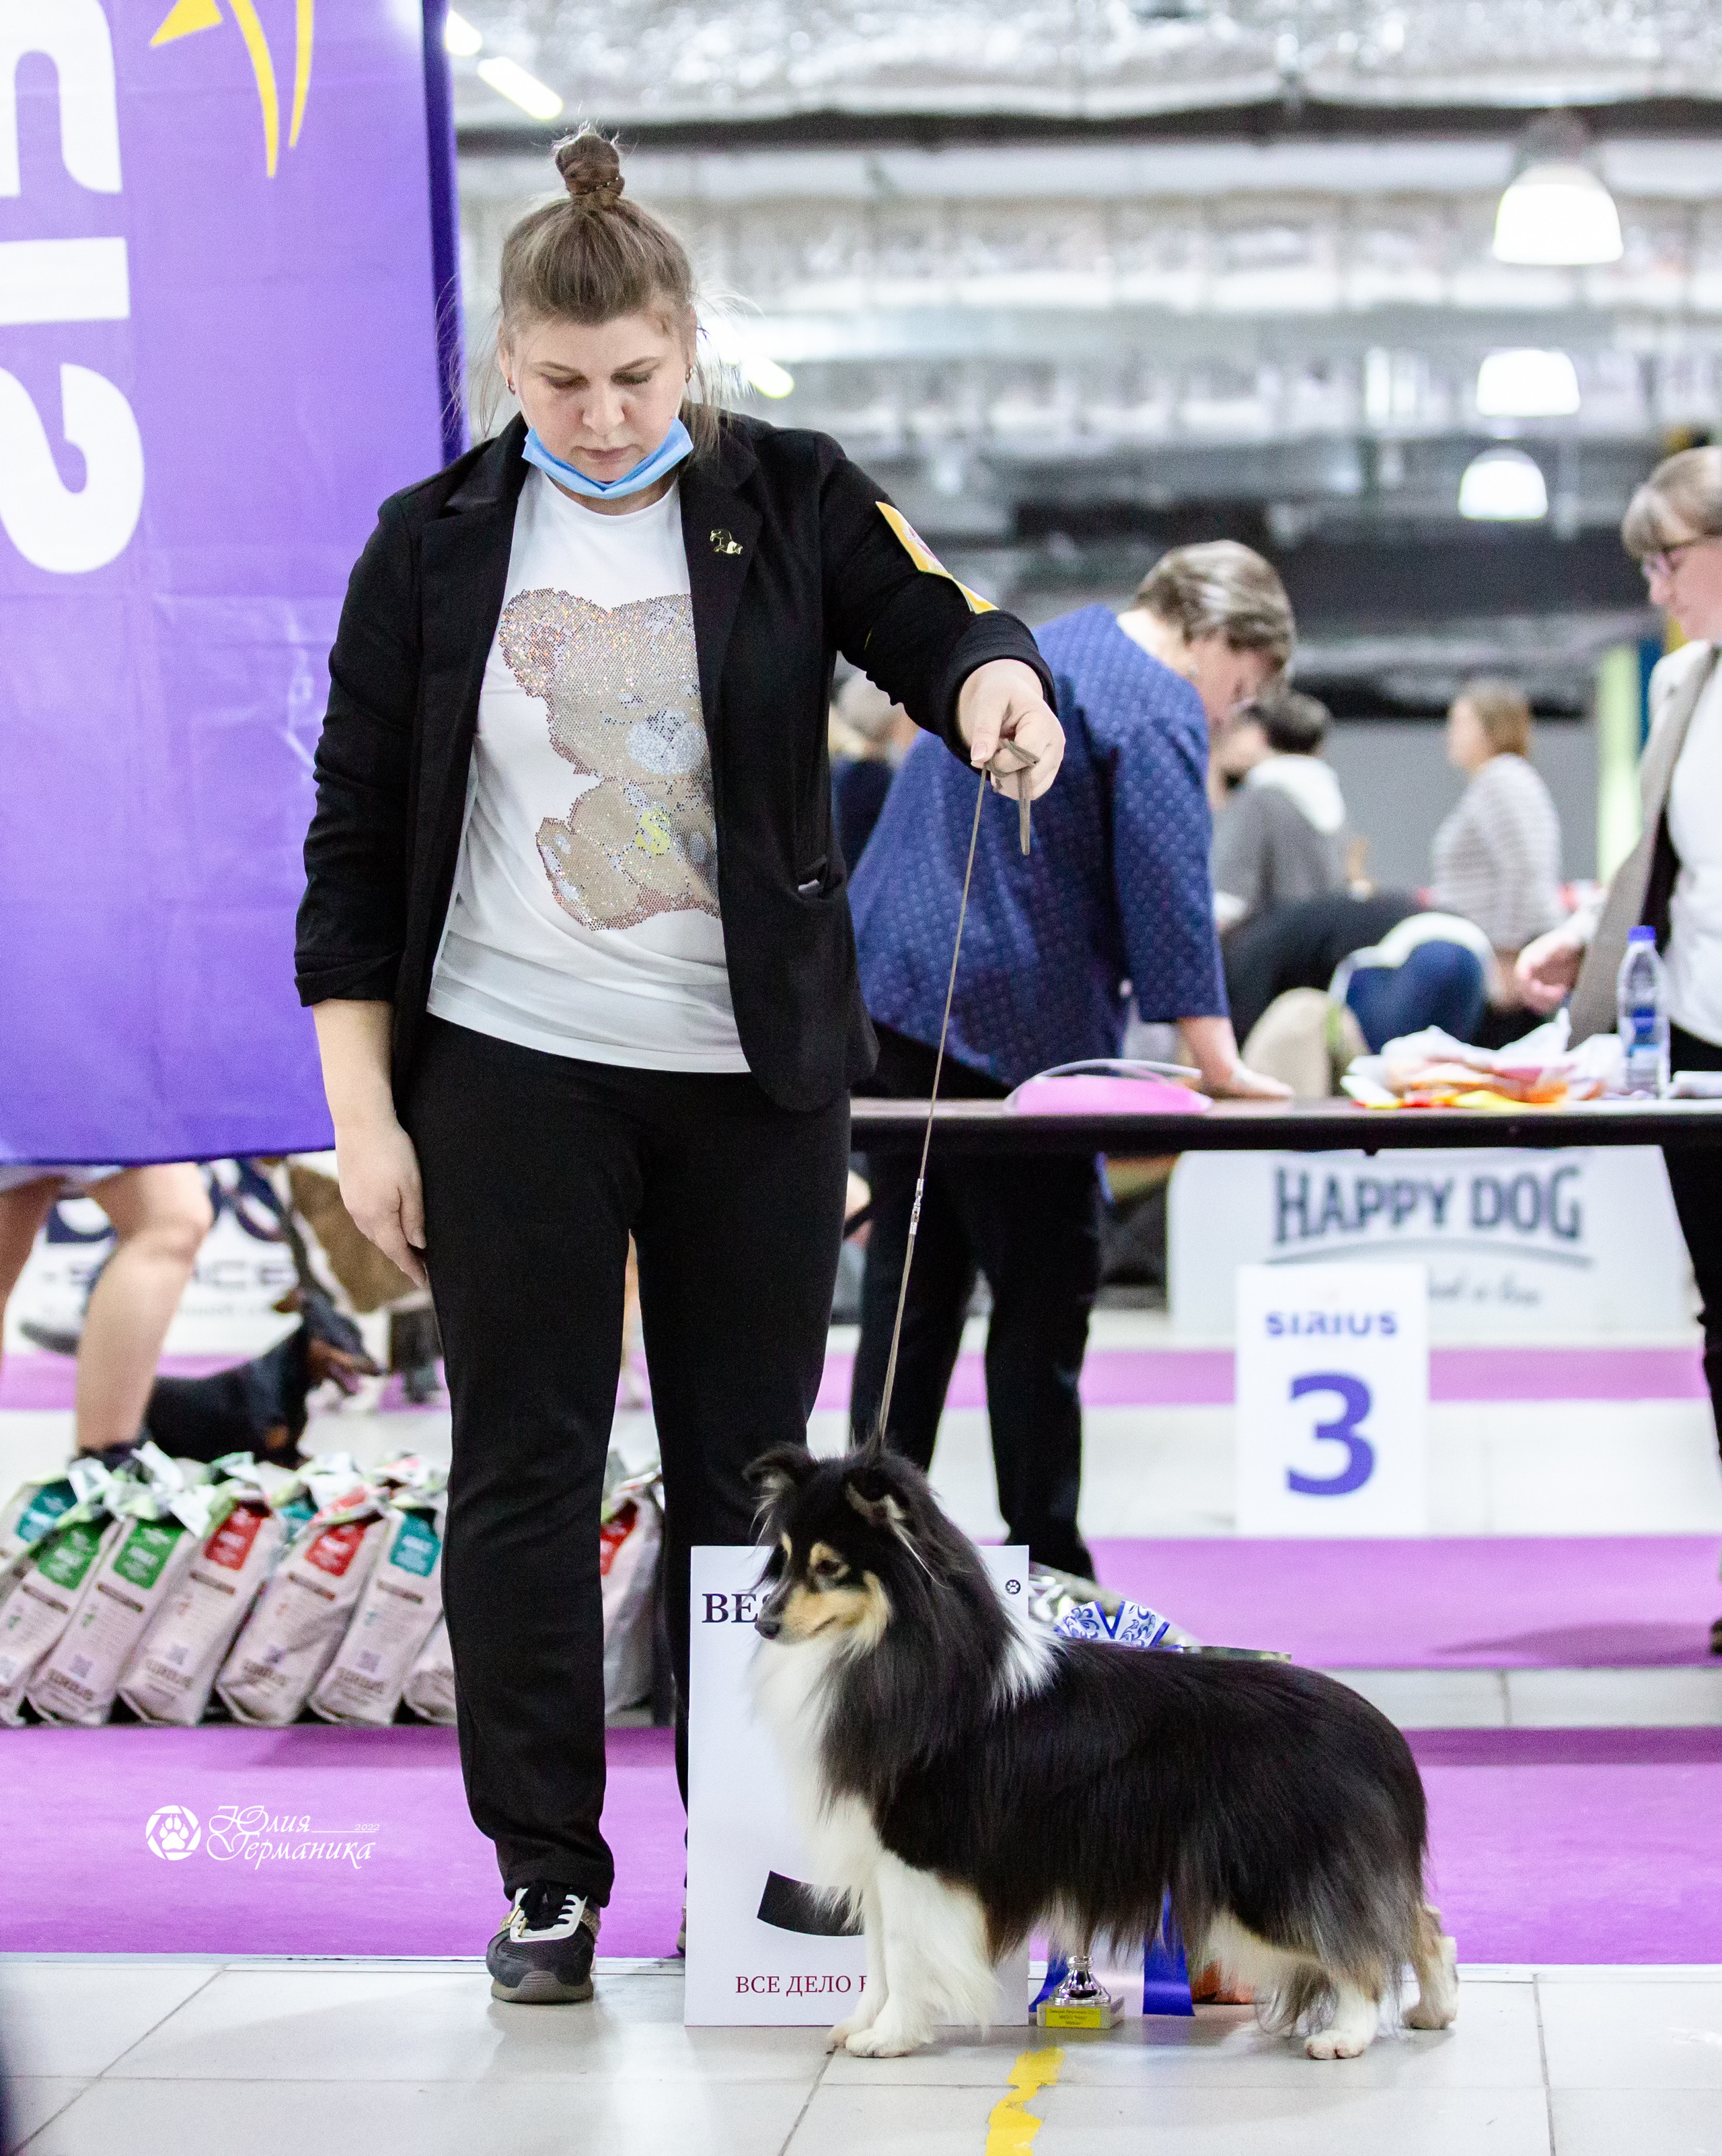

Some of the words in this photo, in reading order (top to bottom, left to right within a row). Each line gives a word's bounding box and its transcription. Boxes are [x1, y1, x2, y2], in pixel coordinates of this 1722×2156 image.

[1275, 1166, 1454, 1244] HAPPY
[1470, 1164, 1583, 1241] DOG
[1265, 1311, 1398, 1337] SIRIUS
[1285, 1371, 1378, 1497] 3
[702, 1593, 772, 1623] BE
[735, 1976, 780, 1993] ВСЕ
[786, 1975, 852, 1997] ДЕЛО
